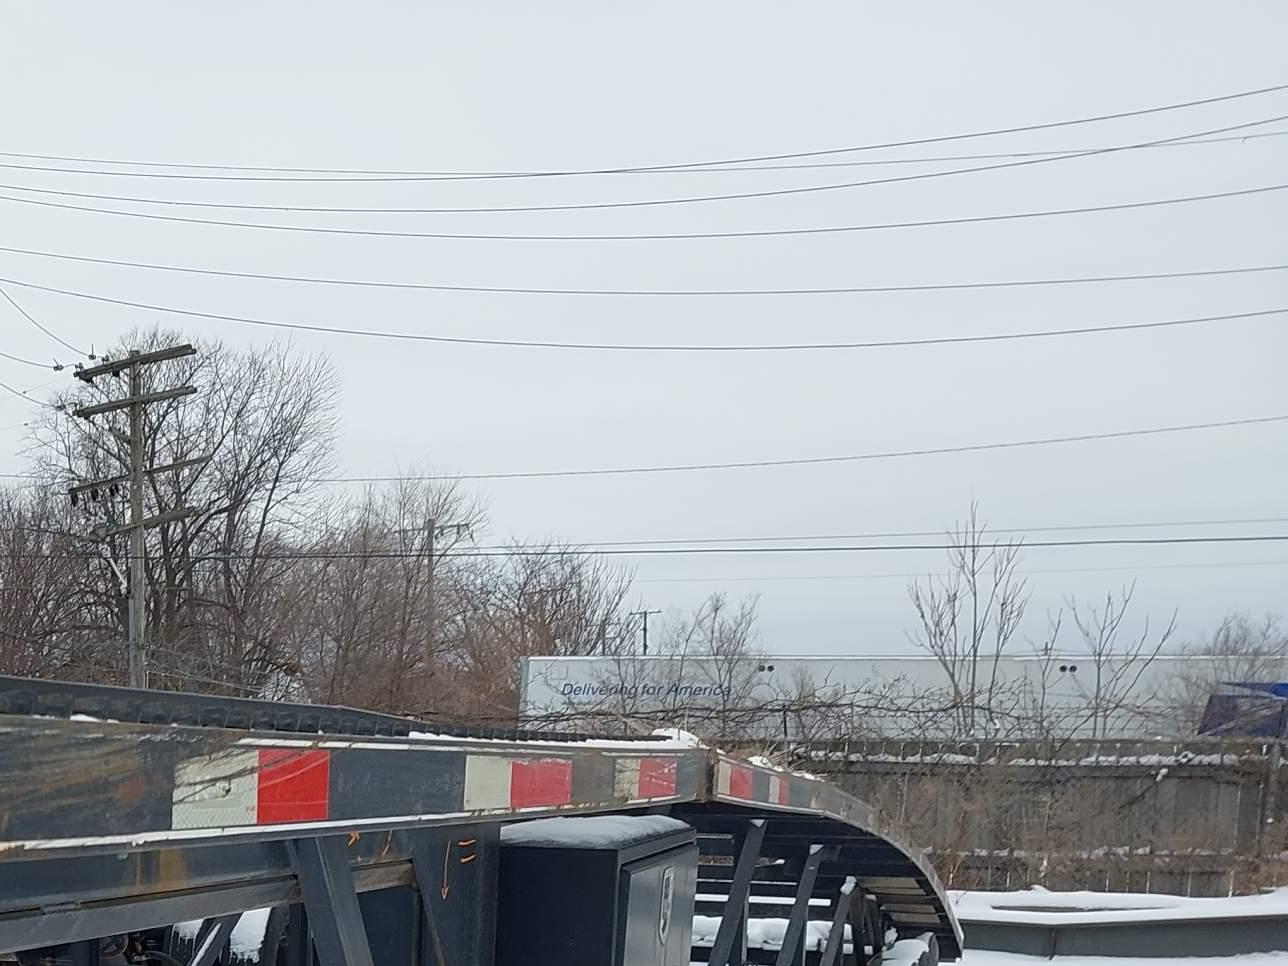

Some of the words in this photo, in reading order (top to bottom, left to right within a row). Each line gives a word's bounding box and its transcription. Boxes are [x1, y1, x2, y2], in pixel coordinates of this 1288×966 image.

[562, 683, 638, 698] Delivering
[639, 683, 664, 697] for
[666, 683, 731, 697] America
